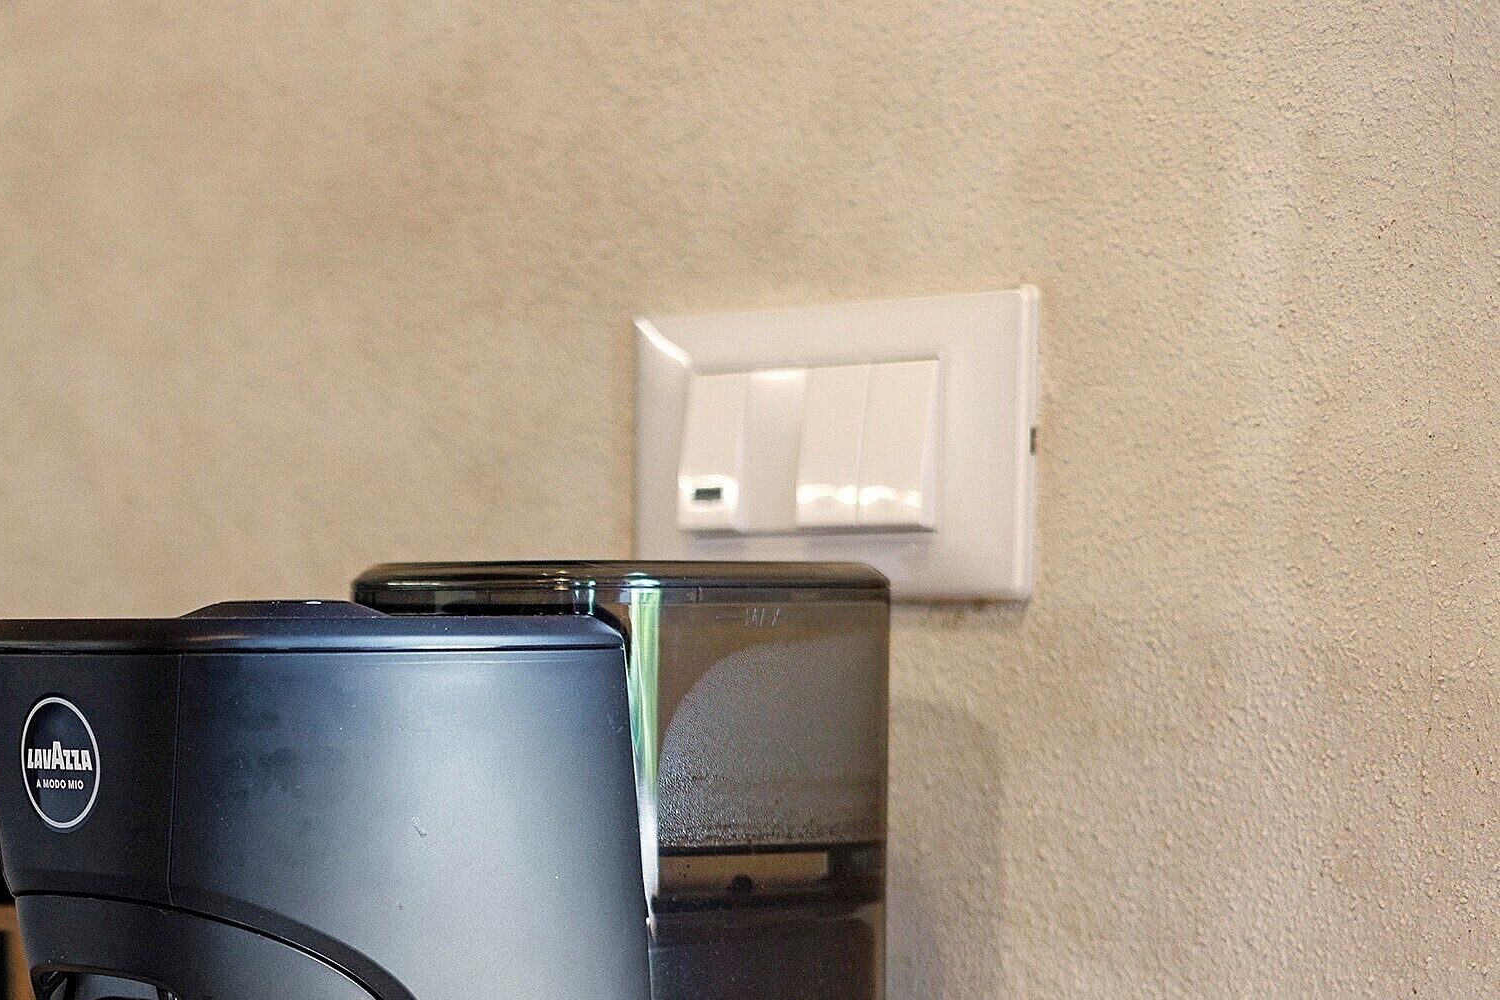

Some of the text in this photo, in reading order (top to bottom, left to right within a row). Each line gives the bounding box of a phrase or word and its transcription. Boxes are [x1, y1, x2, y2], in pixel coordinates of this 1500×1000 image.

[27, 741, 93, 771] LAVAZZA
[36, 779, 84, 790] A MODO MIO
